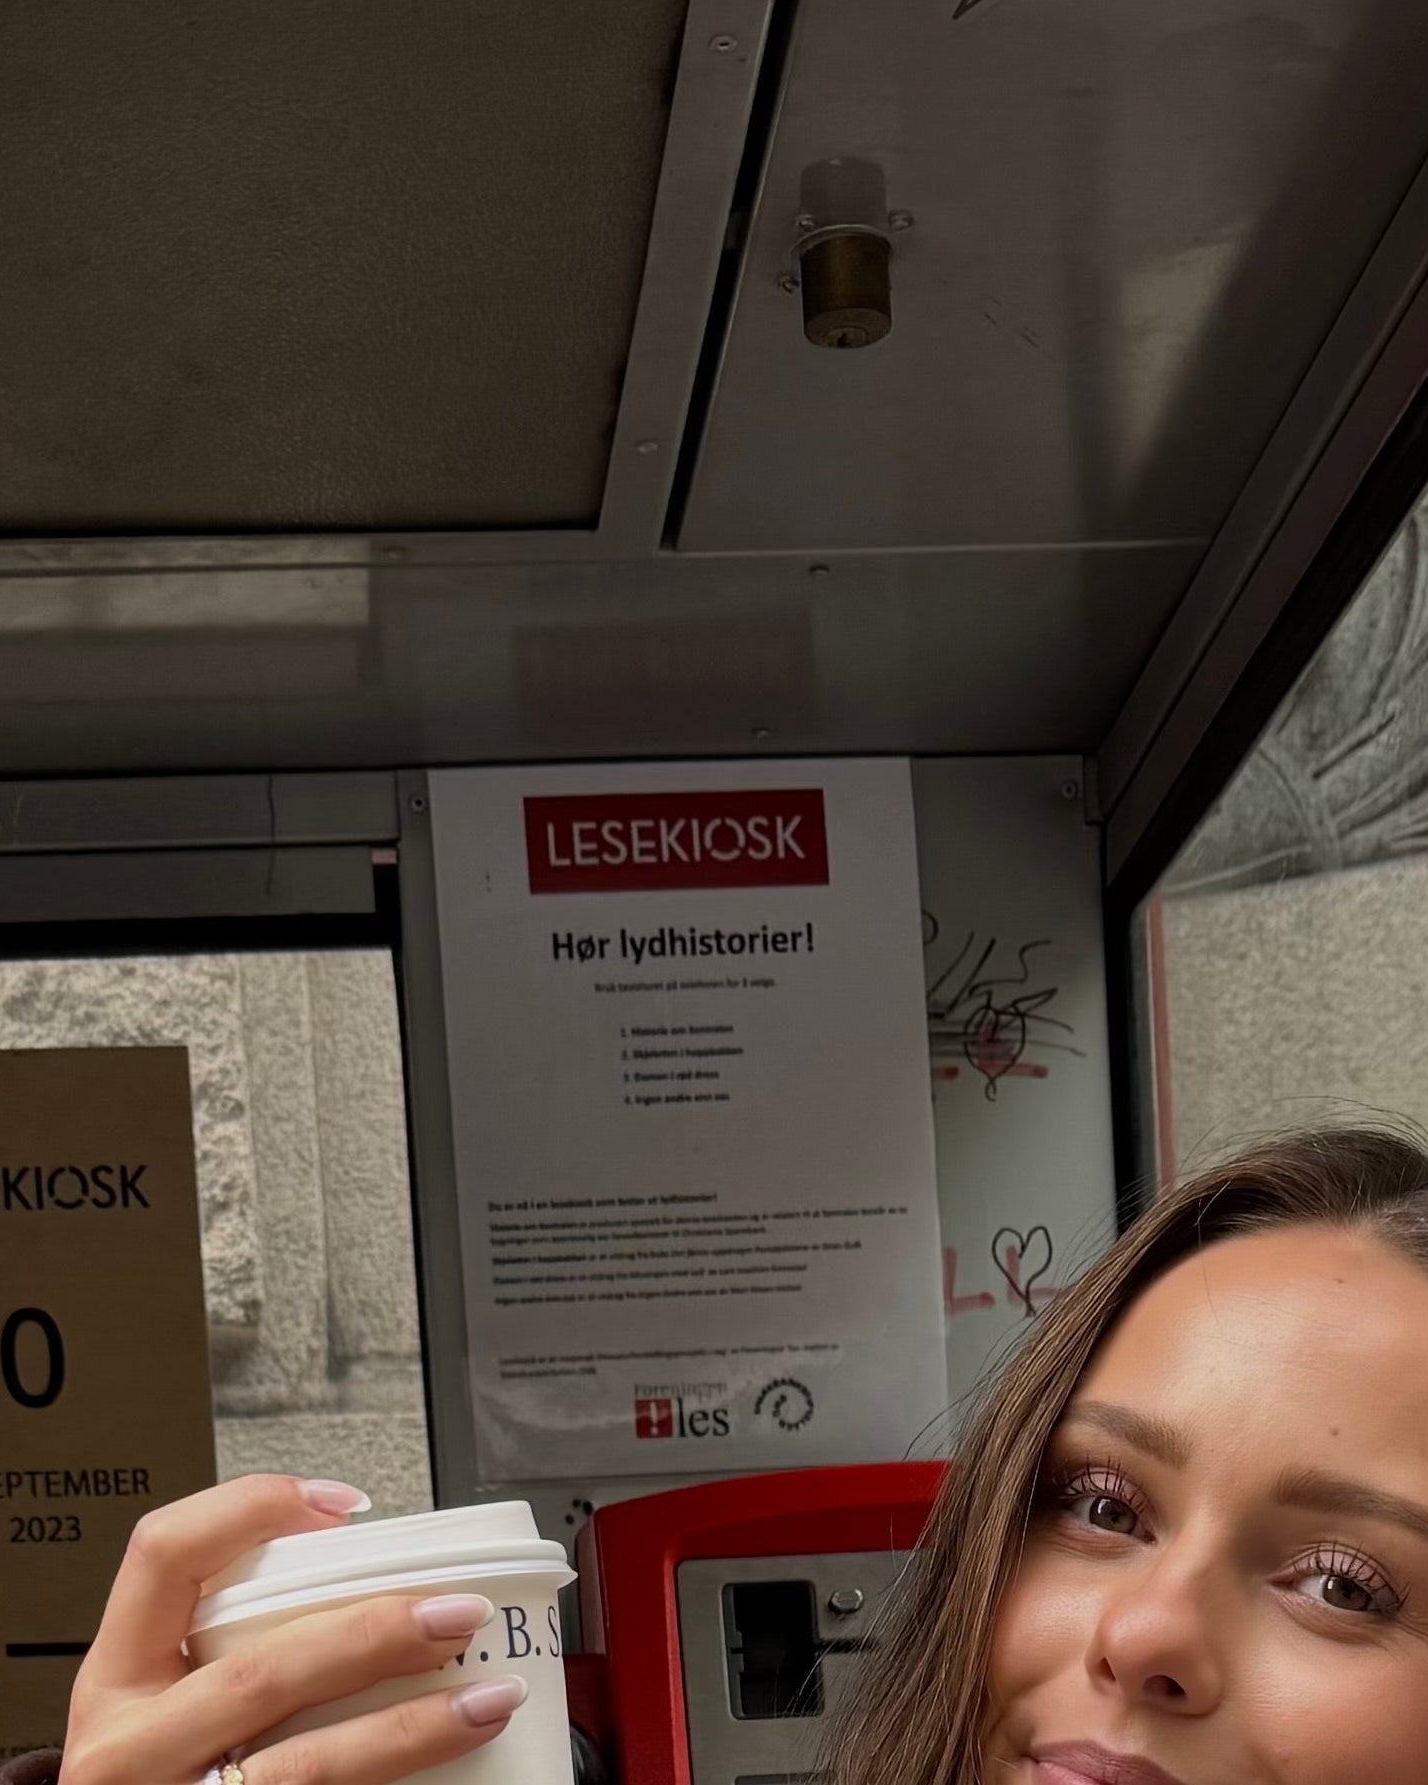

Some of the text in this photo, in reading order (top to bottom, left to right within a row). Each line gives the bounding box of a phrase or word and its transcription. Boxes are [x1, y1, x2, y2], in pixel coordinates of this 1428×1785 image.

[546, 815, 805, 867] LESEKIOSK
[551, 923, 815, 962] Hør lydhistorier!
[0, 1307, 66, 1410] 0
[9, 1516, 83, 1544] 2023
